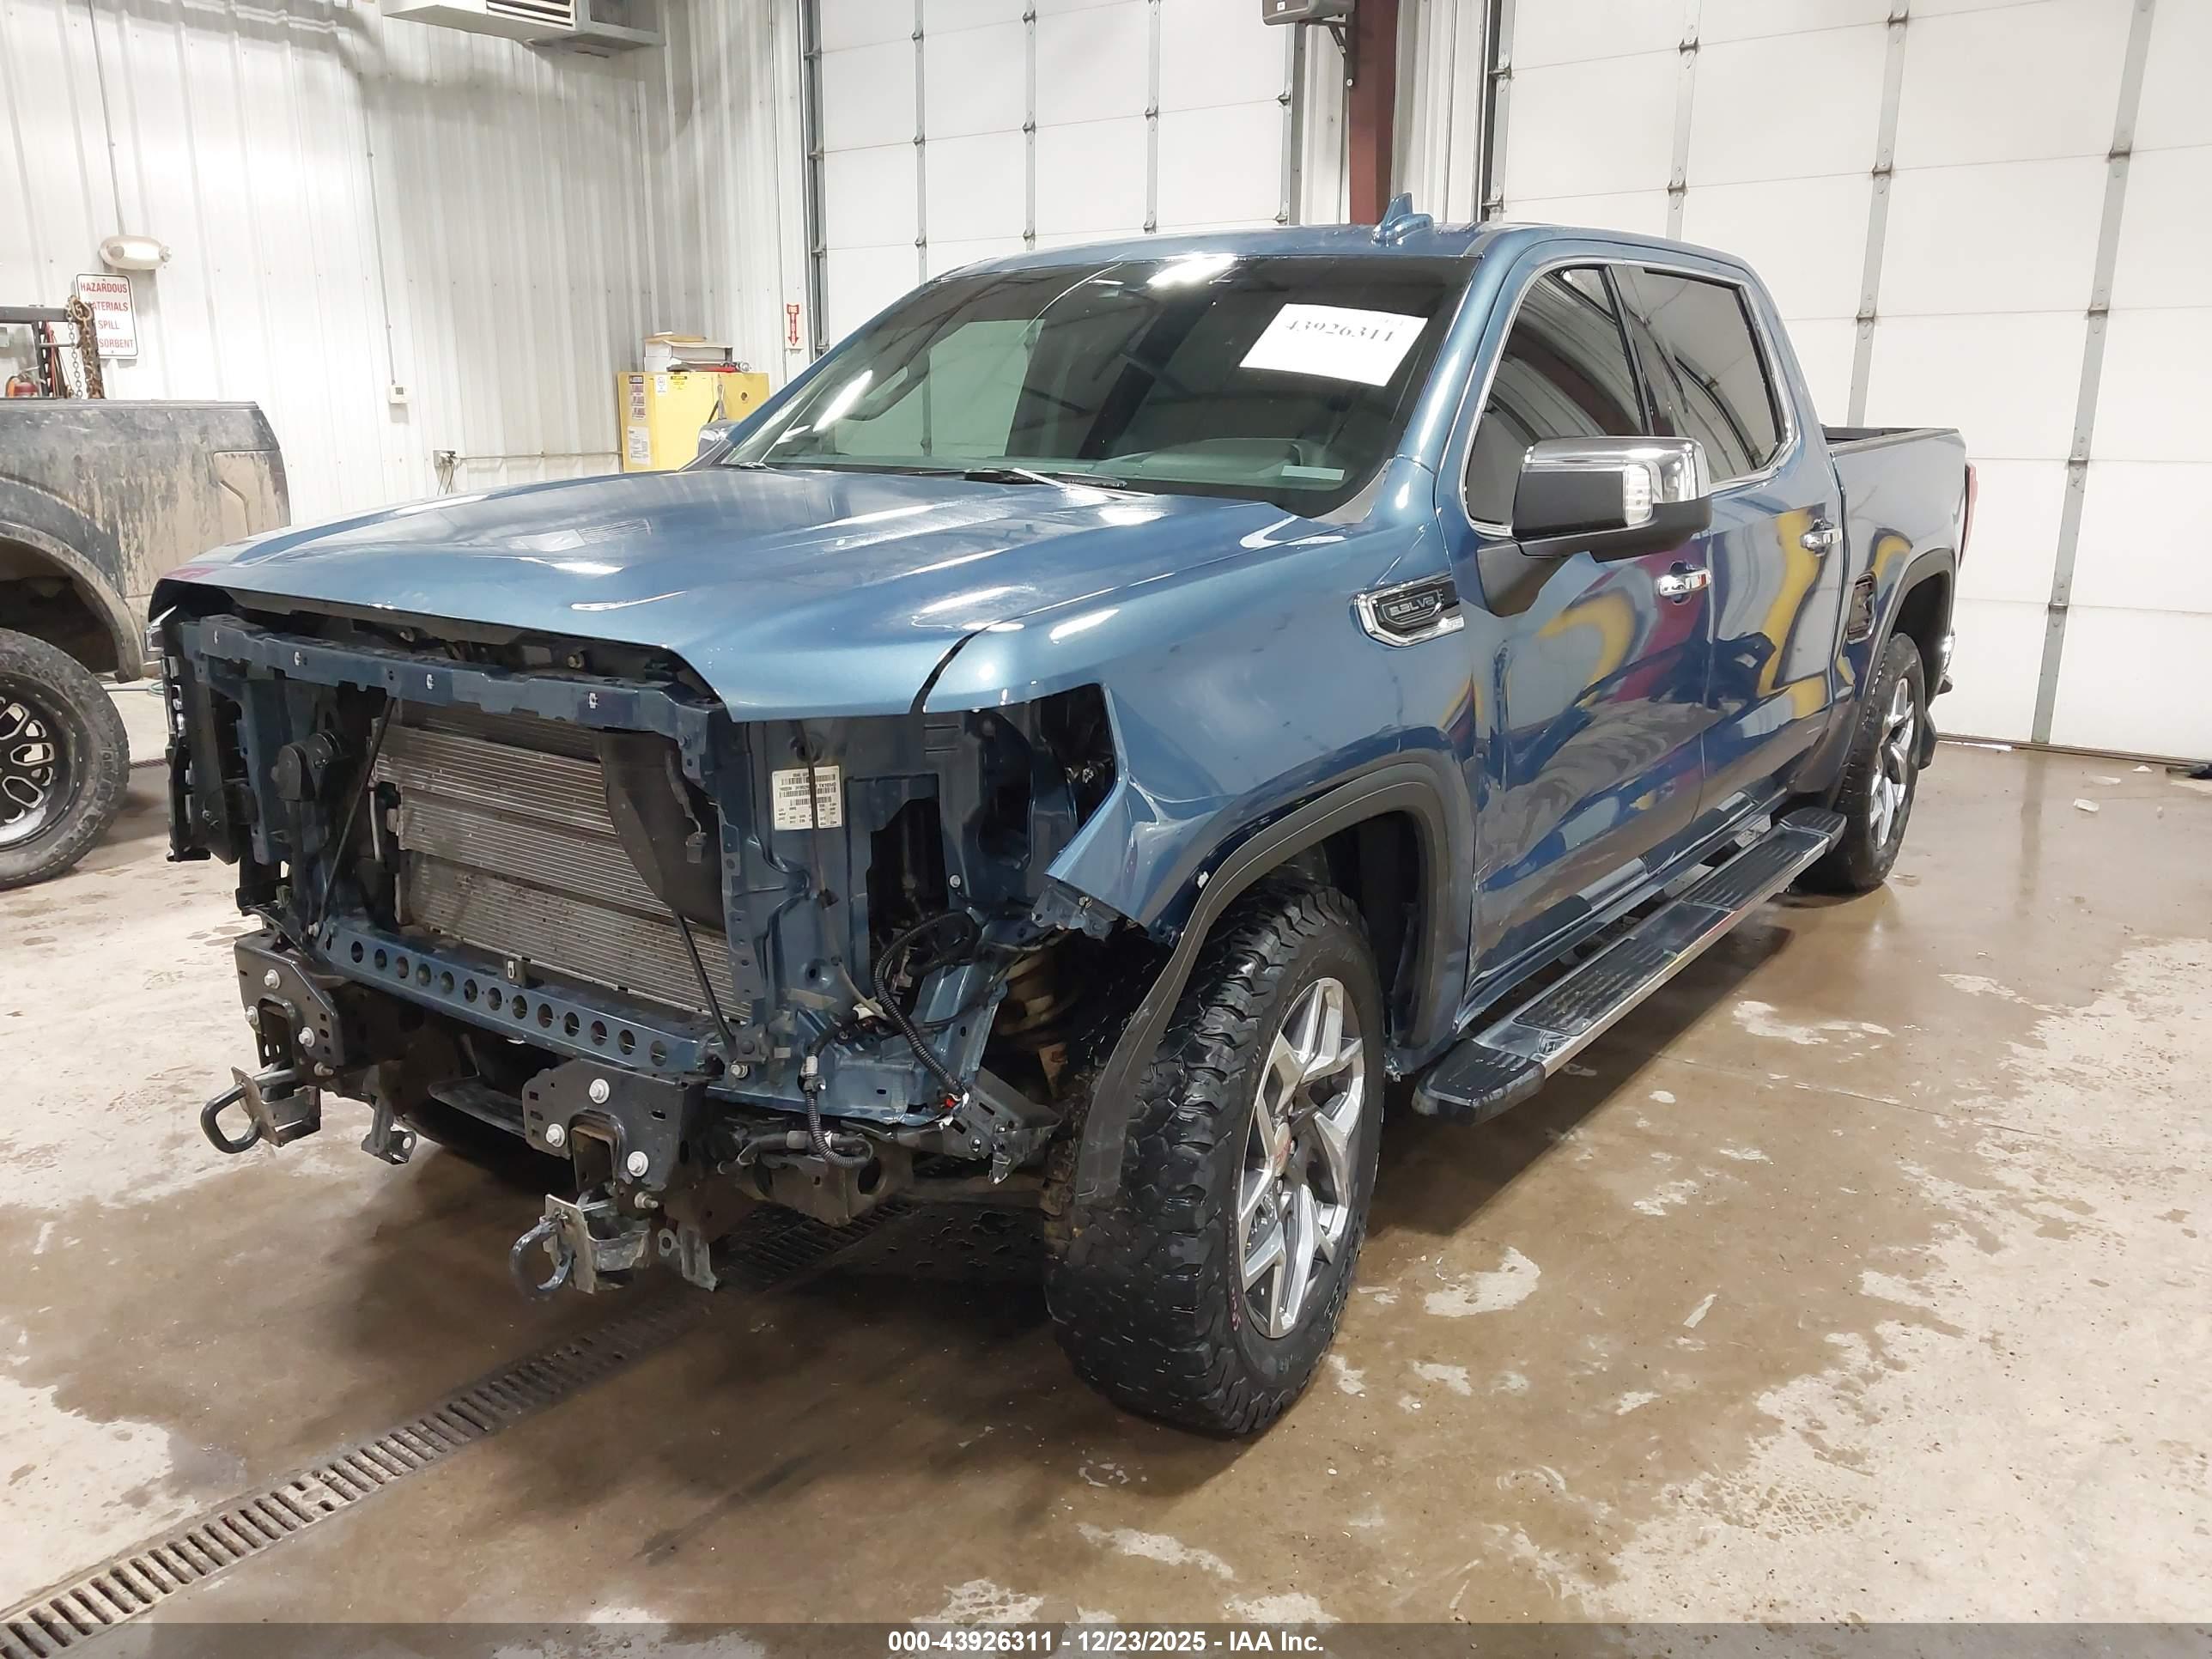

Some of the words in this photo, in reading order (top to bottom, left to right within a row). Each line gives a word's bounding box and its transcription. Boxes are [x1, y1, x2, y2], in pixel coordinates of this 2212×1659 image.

[81, 281, 128, 294] HAZARDOUS
[98, 319, 120, 330] SPILL
[99, 337, 133, 349] SORBENT
